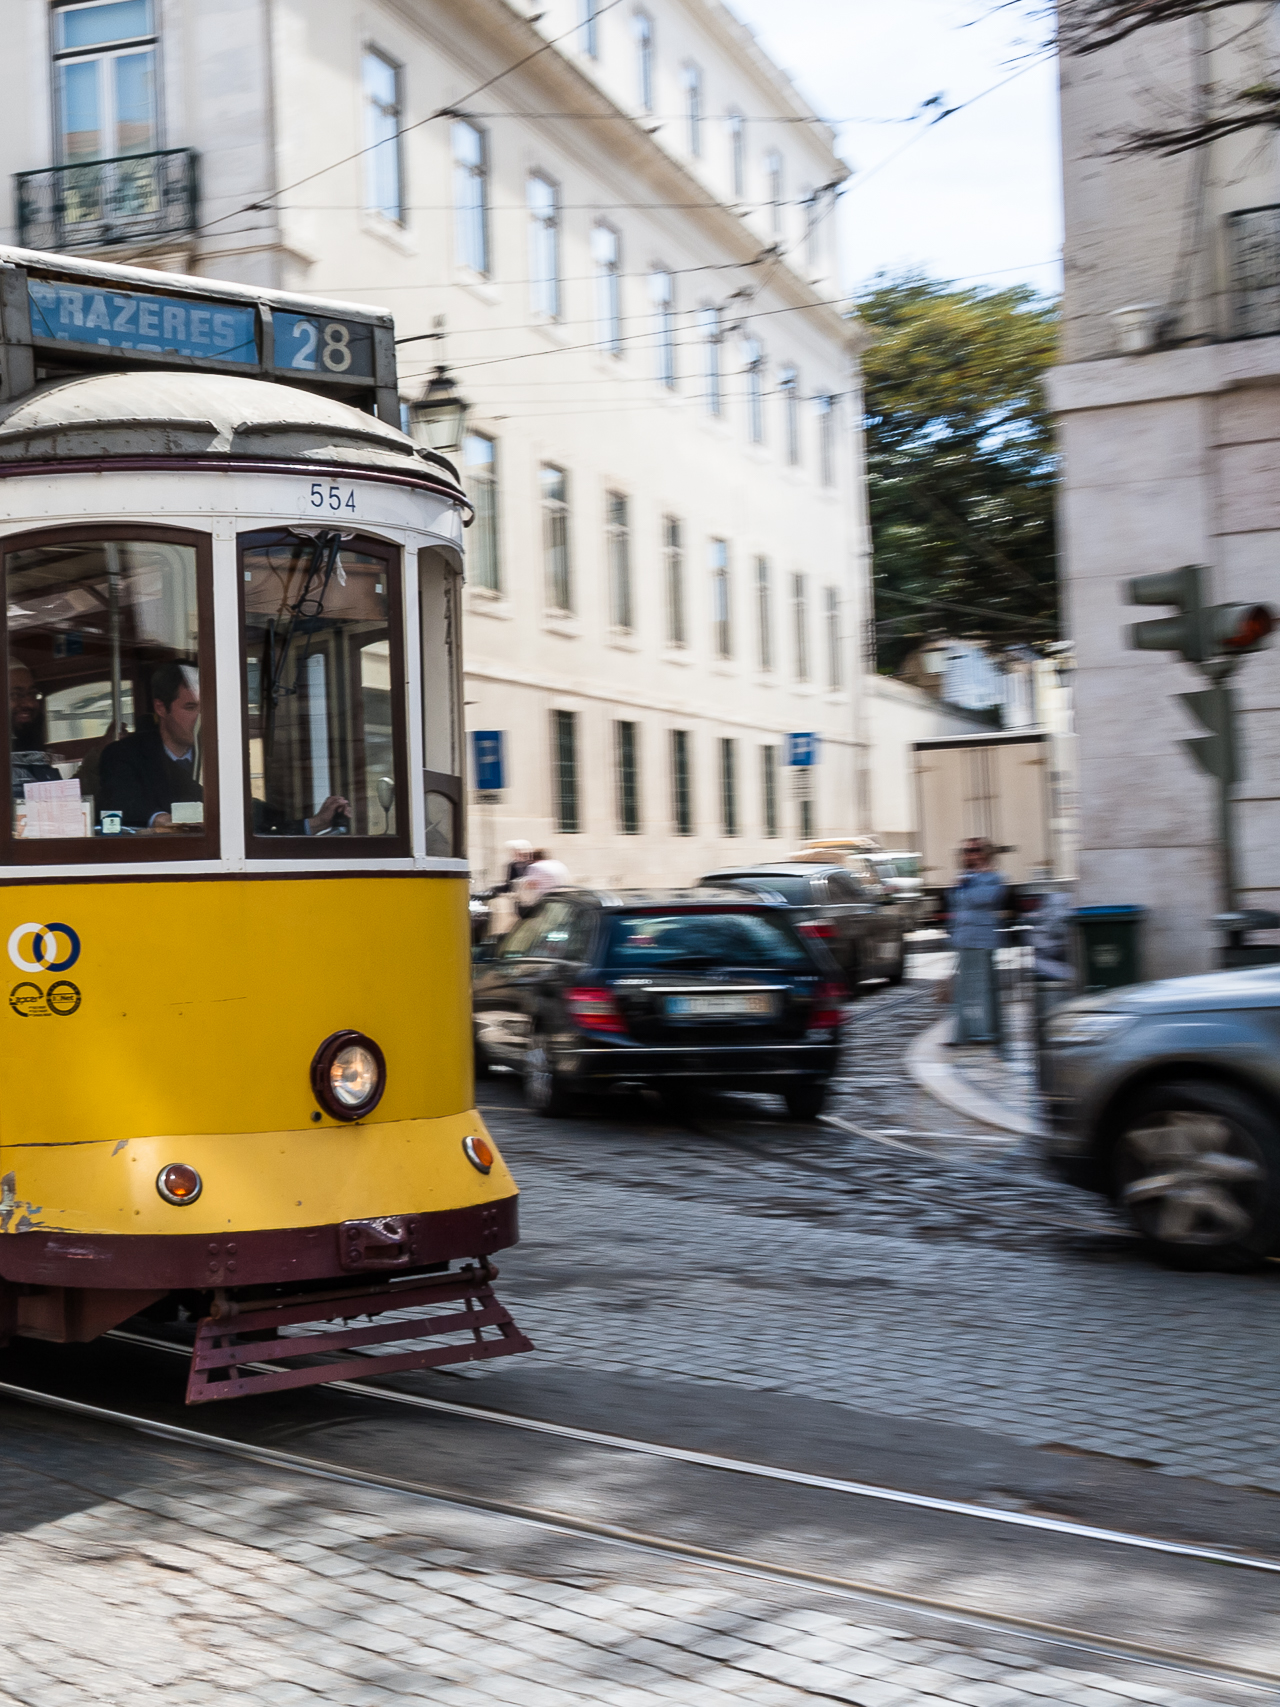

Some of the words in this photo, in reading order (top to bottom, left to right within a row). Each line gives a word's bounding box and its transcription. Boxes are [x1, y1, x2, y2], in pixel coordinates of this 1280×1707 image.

[32, 284, 235, 346] PRAZERES
[292, 321, 352, 373] 28
[310, 483, 356, 513] 554
